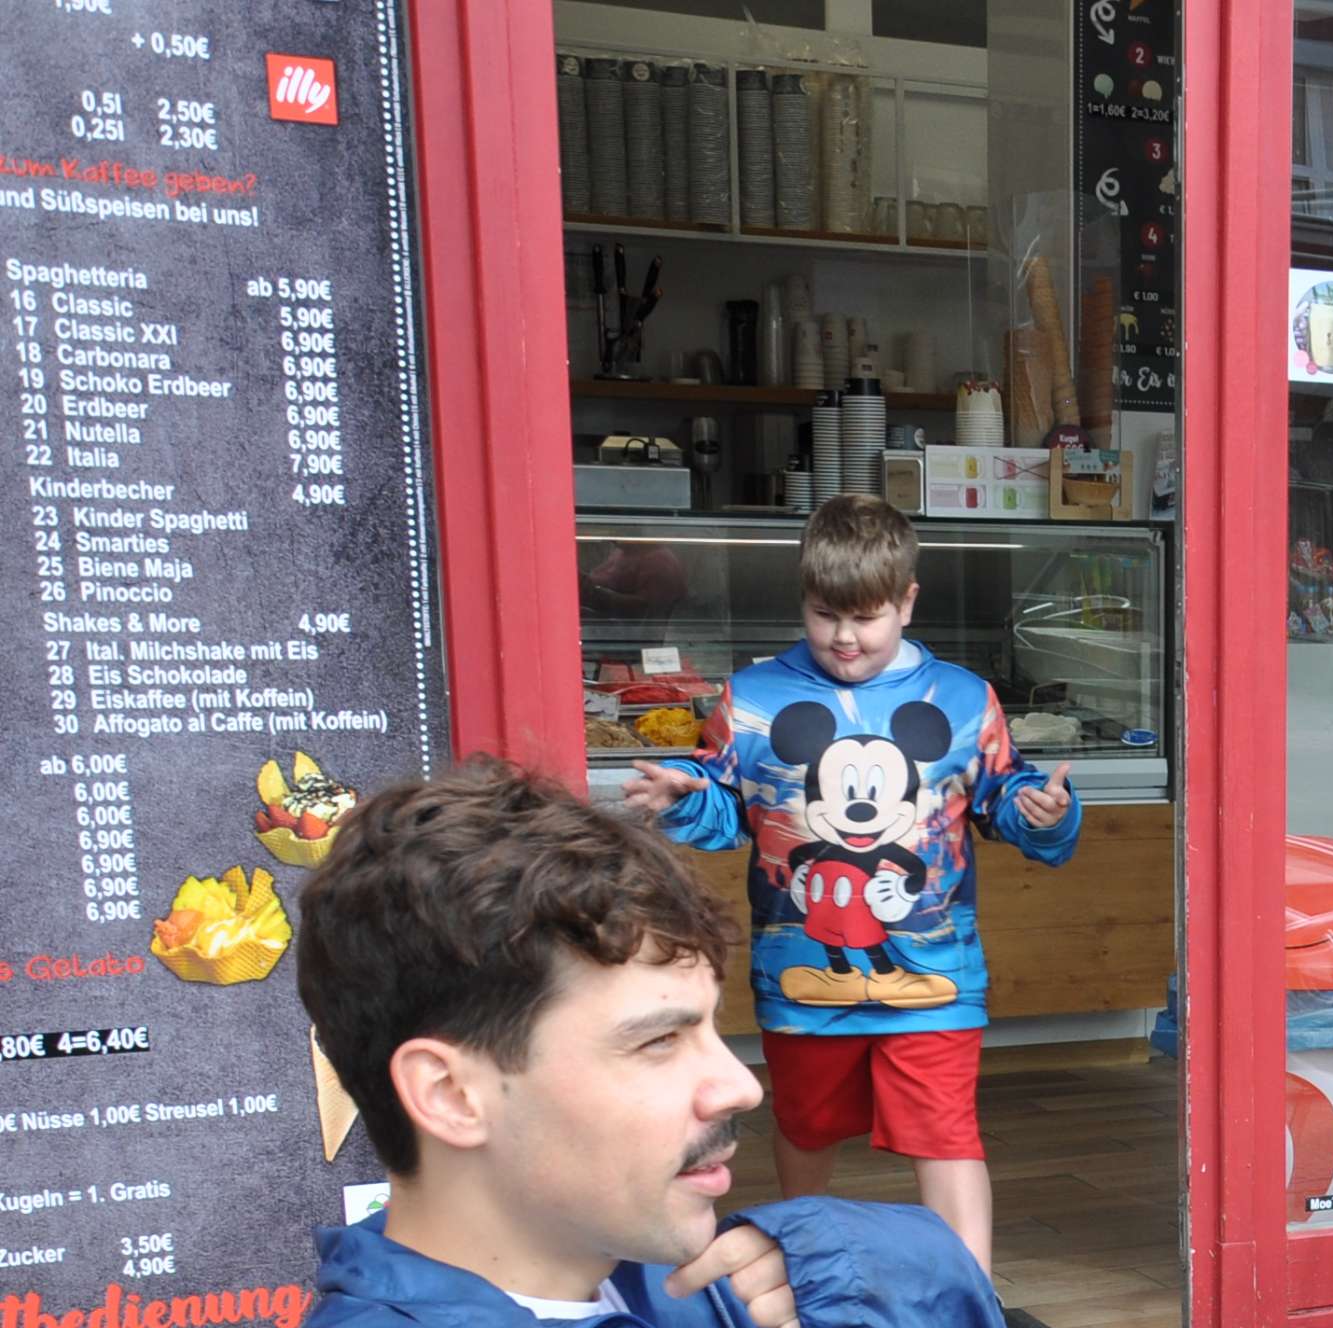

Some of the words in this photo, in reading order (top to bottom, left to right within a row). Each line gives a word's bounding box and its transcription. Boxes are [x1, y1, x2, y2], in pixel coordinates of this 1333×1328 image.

[151, 32, 210, 59] 0,50€
[1135, 47, 1145, 64] 2
[276, 66, 331, 113] illy
[81, 90, 122, 115] 0,5l
[157, 98, 216, 124] 2,50€
[71, 115, 125, 142] 0,25l
[160, 125, 218, 150] 2,30€
[1151, 142, 1161, 159] 3
[62, 158, 157, 188] Kaffee
[163, 169, 258, 198] geben?
[41, 189, 170, 221] Süßspeisen
[176, 199, 207, 222] bei
[213, 204, 258, 227] uns!
[1147, 226, 1157, 244] 4
[7, 258, 148, 290] Spaghetteria
[247, 277, 273, 297] ab
[278, 279, 332, 303] 5,90€
[10, 290, 37, 311] 16
[52, 293, 134, 318] Classic
[280, 307, 334, 330] 5,90€
[13, 316, 38, 337] 17
[55, 318, 136, 343] Classic
[281, 331, 335, 354] 6,90€
[16, 342, 42, 363] 18
[57, 344, 171, 370] Carbonara
[283, 356, 337, 379] 6,90€
[18, 368, 45, 389] 19
[60, 369, 143, 395] Schoko
[148, 375, 232, 398] Erdbeer
[285, 380, 339, 403] 6,90€
[21, 394, 47, 414] 20
[63, 395, 148, 419] Erdbeer
[287, 405, 341, 428] 6,90€
[23, 420, 48, 440] 21
[65, 420, 141, 444] Nutella
[288, 429, 342, 452] 6,90€
[26, 445, 53, 466] 22
[67, 446, 120, 468] Italia
[290, 454, 344, 477] 7,90€
[29, 476, 175, 501] Kinderbecher
[292, 485, 345, 508] 4,90€
[32, 506, 59, 526] 23
[74, 507, 144, 529] Kinder
[150, 510, 249, 535] Spaghetti
[35, 531, 61, 551] 24
[75, 532, 170, 554] Smarties
[37, 556, 64, 577] 25
[79, 556, 139, 579] Biene
[145, 558, 194, 583] Maja
[40, 581, 66, 601] 26
[80, 581, 173, 603] Pinoccio
[43, 612, 122, 633] Shakes
[128, 613, 144, 633] &
[150, 613, 201, 634] More
[298, 612, 351, 636] 4,90€
[46, 640, 71, 661] 27
[86, 640, 125, 662] Ital.
[129, 640, 246, 662] Milchshake
[250, 640, 282, 661] mit
[287, 640, 319, 661] Eis
[49, 665, 74, 686] 28
[88, 664, 122, 686] Eis
[127, 664, 247, 686] Schokolade
[50, 689, 76, 710] 29
[91, 688, 186, 711] Eiskaffee
[191, 687, 230, 714] (mit
[236, 686, 315, 712] Koffein)
[54, 714, 79, 735] 30
[93, 713, 183, 740] Affogato
[188, 711, 206, 733] al
[210, 710, 264, 733] Caffe
[268, 710, 306, 736] (mit
[311, 709, 389, 735] Koffein)
[40, 756, 66, 775] ab
[72, 753, 128, 779] 6,00€
[74, 781, 130, 805] 6,00€
[77, 805, 132, 829] 6,00€
[79, 828, 135, 853] 6,90€
[81, 852, 137, 876] 6,90€
[84, 876, 140, 900] 6,90€
[86, 900, 142, 924] 6,90€
[57, 1026, 149, 1056] 4=6,40€
[22, 1111, 84, 1131] Nüsse
[90, 1104, 142, 1128] 1,00€
[146, 1098, 224, 1123] Streusel
[229, 1093, 278, 1117] 1,00€
[88, 1185, 104, 1204] 1.
[110, 1180, 171, 1202] Gratis
[0, 1245, 65, 1269] Zucker
[121, 1233, 173, 1258] 3,50€
[123, 1256, 175, 1278] 4,90€
